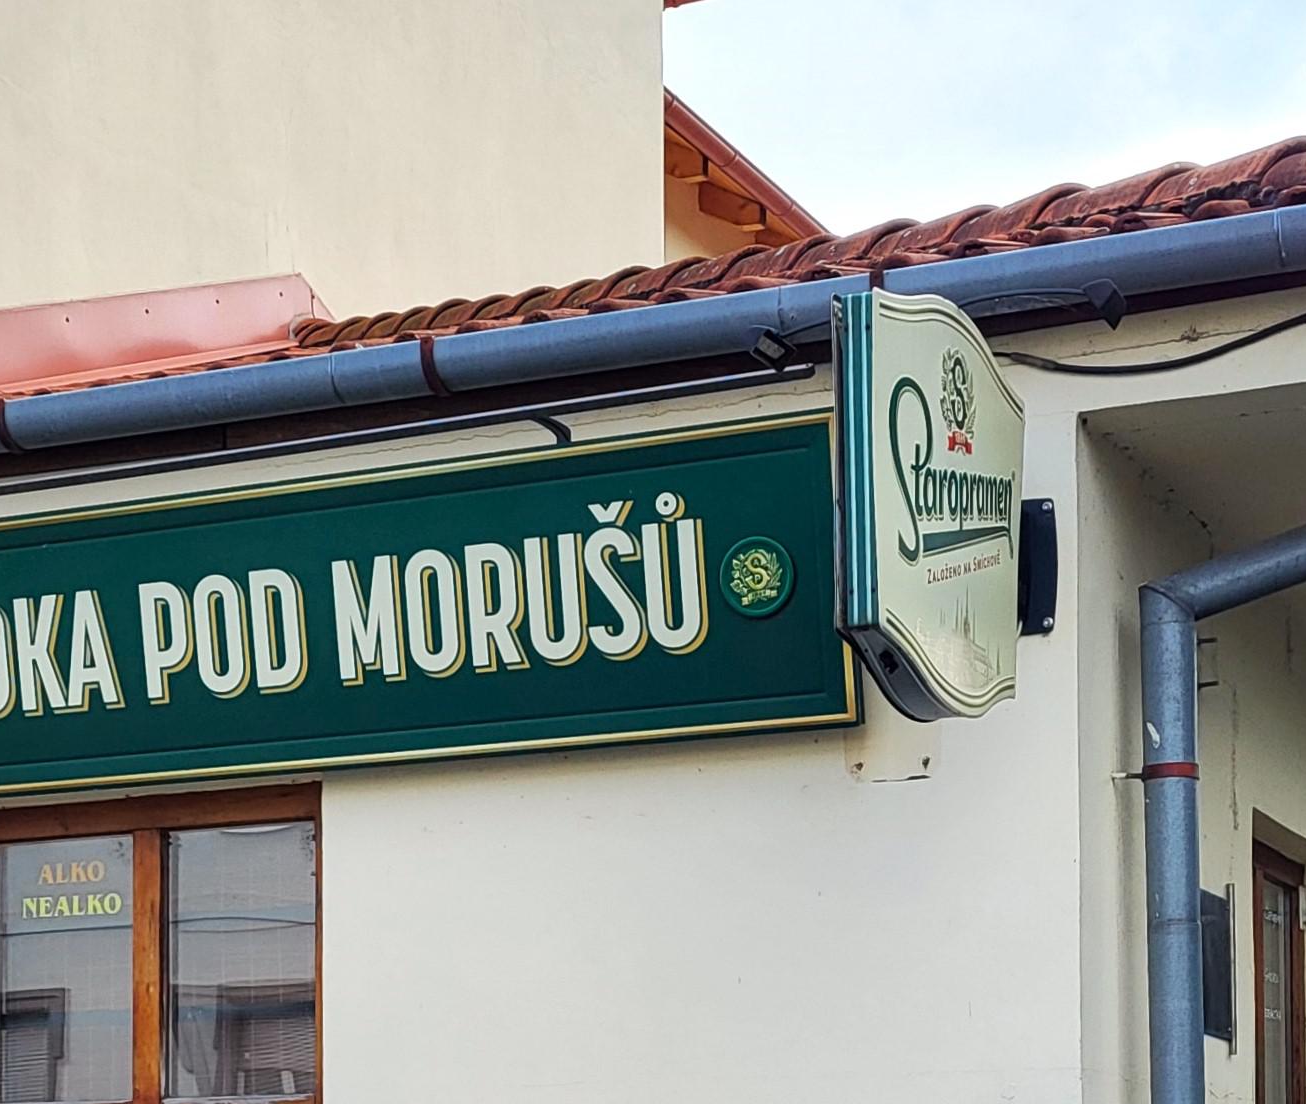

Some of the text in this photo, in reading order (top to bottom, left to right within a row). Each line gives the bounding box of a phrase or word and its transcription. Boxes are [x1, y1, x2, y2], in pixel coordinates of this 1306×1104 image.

[888, 376, 1015, 562] Staropramen
[139, 568, 307, 704] POD
[331, 491, 708, 687] MORUŠŮ
[22, 892, 122, 919] NEALKO
[37, 860, 106, 885] ALKO
